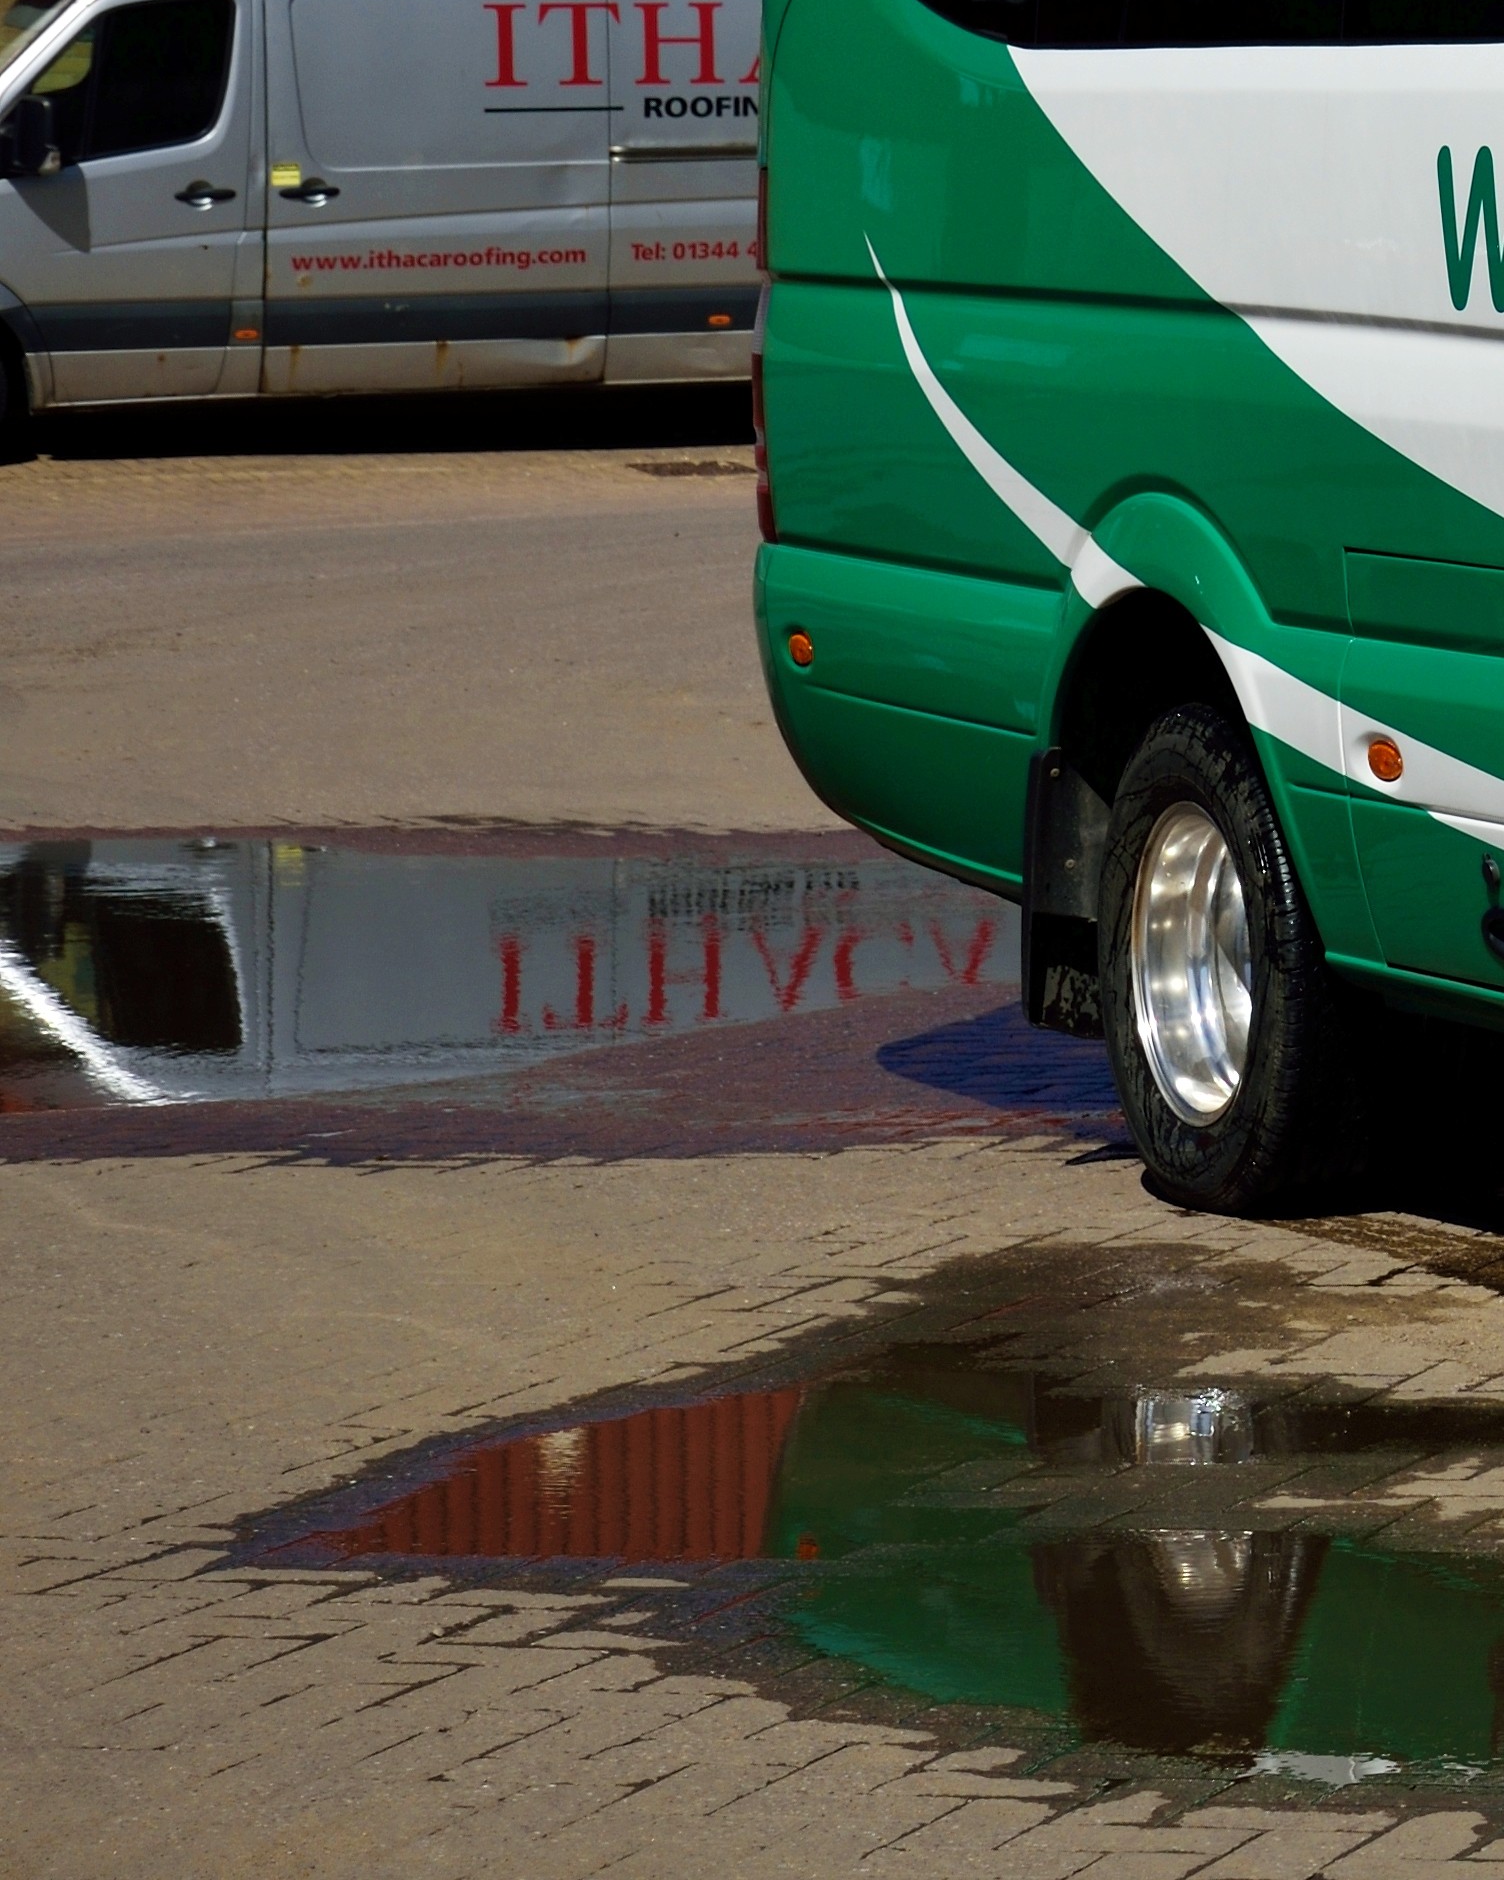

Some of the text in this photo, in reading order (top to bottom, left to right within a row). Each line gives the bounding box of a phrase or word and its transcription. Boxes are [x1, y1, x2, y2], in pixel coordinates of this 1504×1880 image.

[484, 1, 761, 87] ITH
[291, 247, 587, 271] www.ithacaroofing.com
[631, 242, 666, 261] Tel:
[672, 241, 740, 261] 01344
